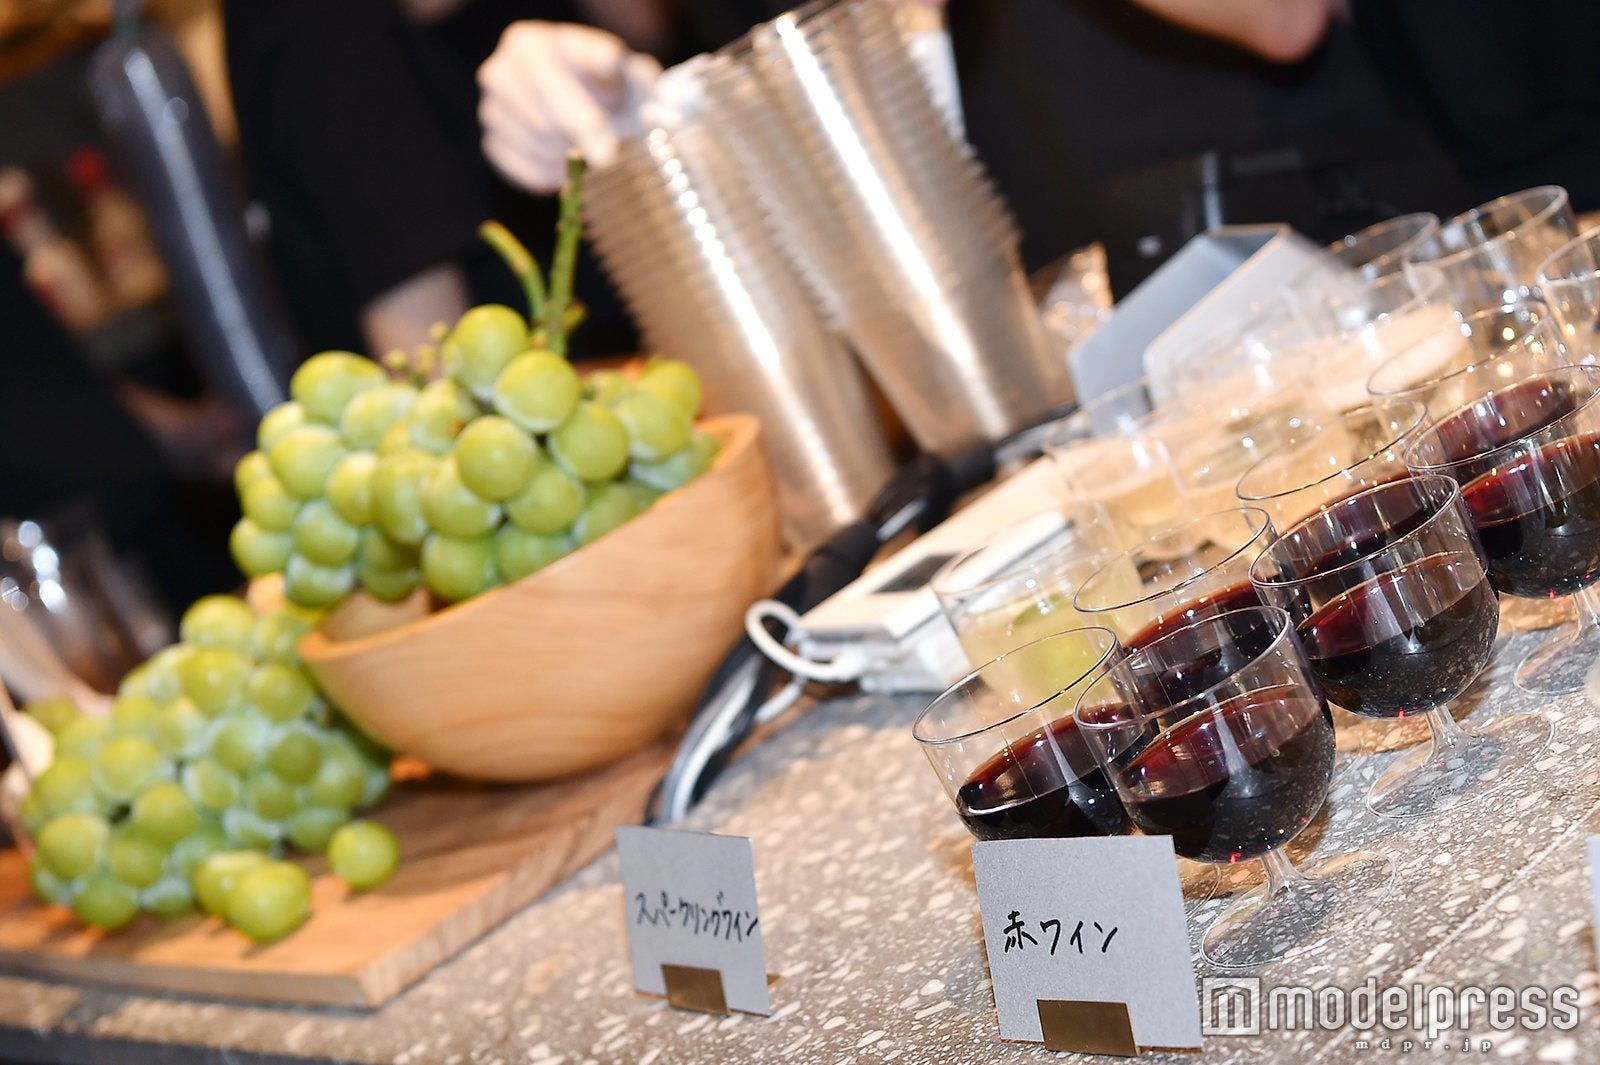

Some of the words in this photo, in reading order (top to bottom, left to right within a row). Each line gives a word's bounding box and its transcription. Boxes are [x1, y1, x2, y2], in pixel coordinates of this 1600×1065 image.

[635, 890, 759, 942] スパークリングワイン
[1003, 910, 1118, 956] 赤ワイン
